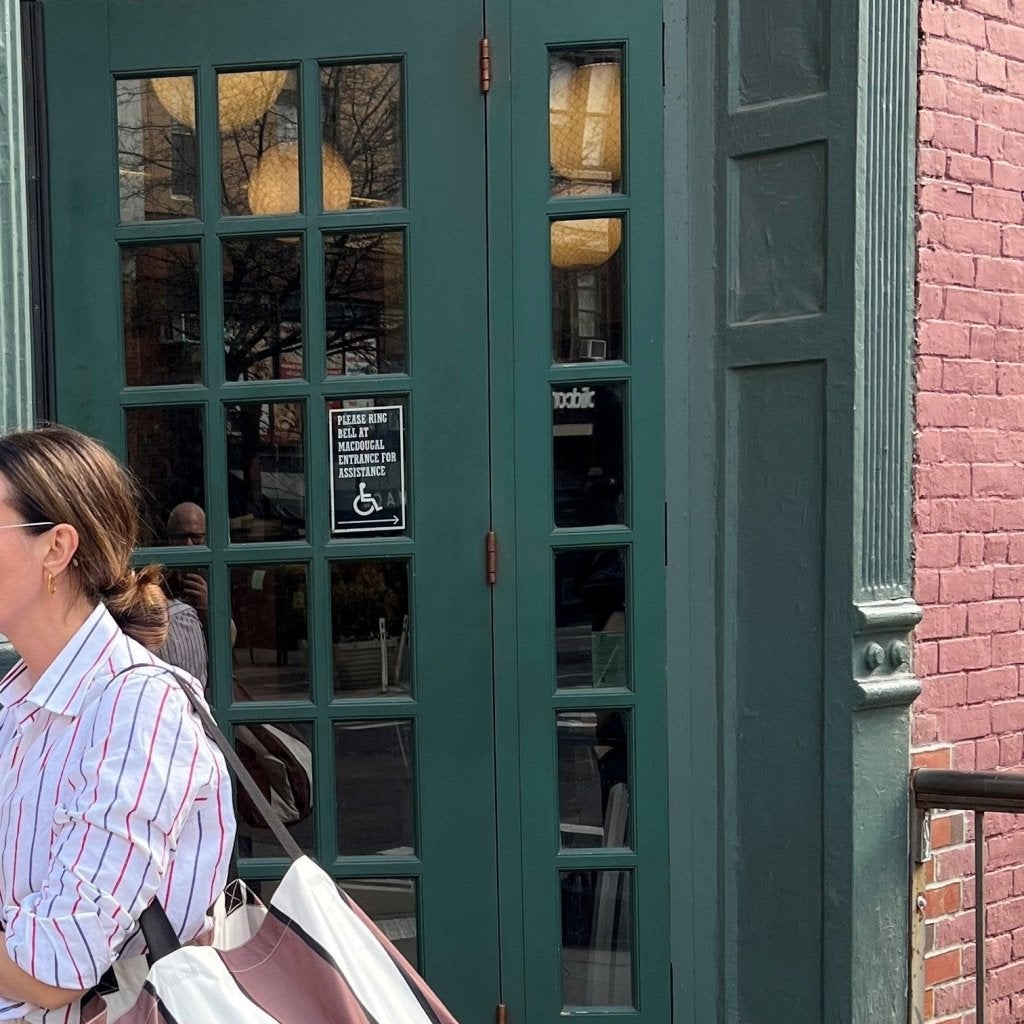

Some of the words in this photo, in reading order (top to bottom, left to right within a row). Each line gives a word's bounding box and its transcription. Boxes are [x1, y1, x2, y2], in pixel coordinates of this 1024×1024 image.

[337, 413, 367, 426] PLEASE
[368, 412, 388, 424] RING
[337, 427, 358, 439] BELL
[358, 426, 370, 438] AT
[337, 439, 385, 452] MACDOUGAL
[338, 452, 380, 466] ENTRANCE
[381, 451, 397, 463] FOR
[338, 465, 386, 479] ASSISTANCE
